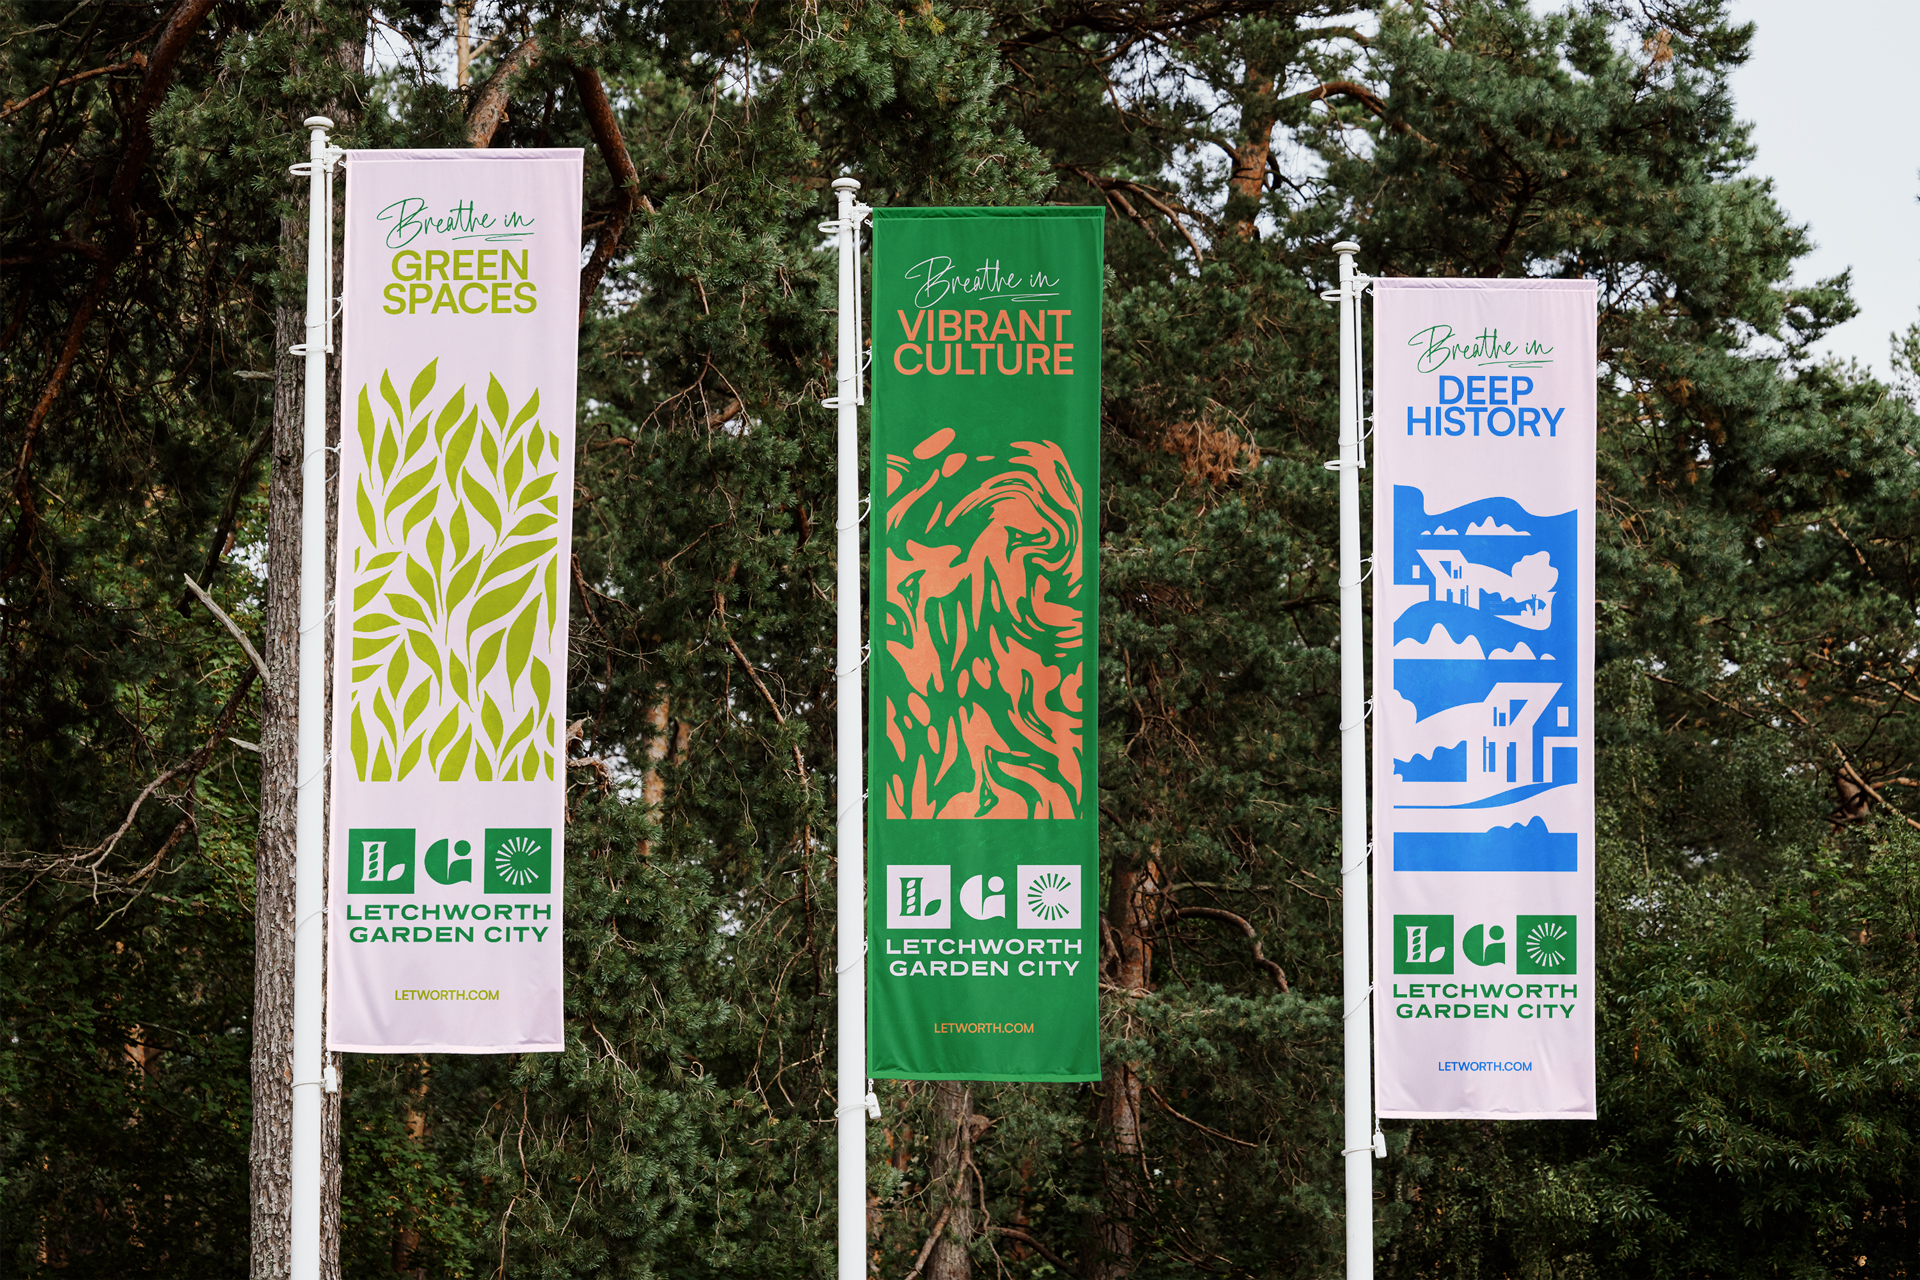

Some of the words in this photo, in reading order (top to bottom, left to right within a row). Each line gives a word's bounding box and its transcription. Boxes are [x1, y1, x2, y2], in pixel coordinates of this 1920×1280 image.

[376, 197, 496, 249] Breathe
[504, 211, 535, 228] in
[391, 249, 529, 281] GREEN
[904, 255, 1022, 309] Breathe
[1029, 271, 1060, 288] in
[382, 282, 537, 315] SPACES
[897, 309, 1072, 342] VIBRANT
[893, 343, 1074, 376] CULTURE
[1407, 324, 1519, 374] Breathe
[1525, 340, 1554, 355] in
[1439, 375, 1534, 405] DEEP
[1407, 406, 1566, 437] HISTORY
[346, 904, 551, 921] LETCHWORTH
[349, 926, 474, 943] GARDEN
[484, 926, 549, 943] CITY
[886, 938, 1082, 955] LETCHWORTH
[889, 960, 1009, 977] GARDEN
[1018, 960, 1080, 977] CITY
[394, 989, 500, 1001] LETWORTH.COM
[1393, 983, 1577, 999] LETCHWORTH
[1396, 1003, 1508, 1019] GARDEN
[1517, 1003, 1575, 1019] CITY
[933, 1022, 1034, 1034] LETWORTH.COM
[1438, 1061, 1532, 1072] LETWORTH.COM
